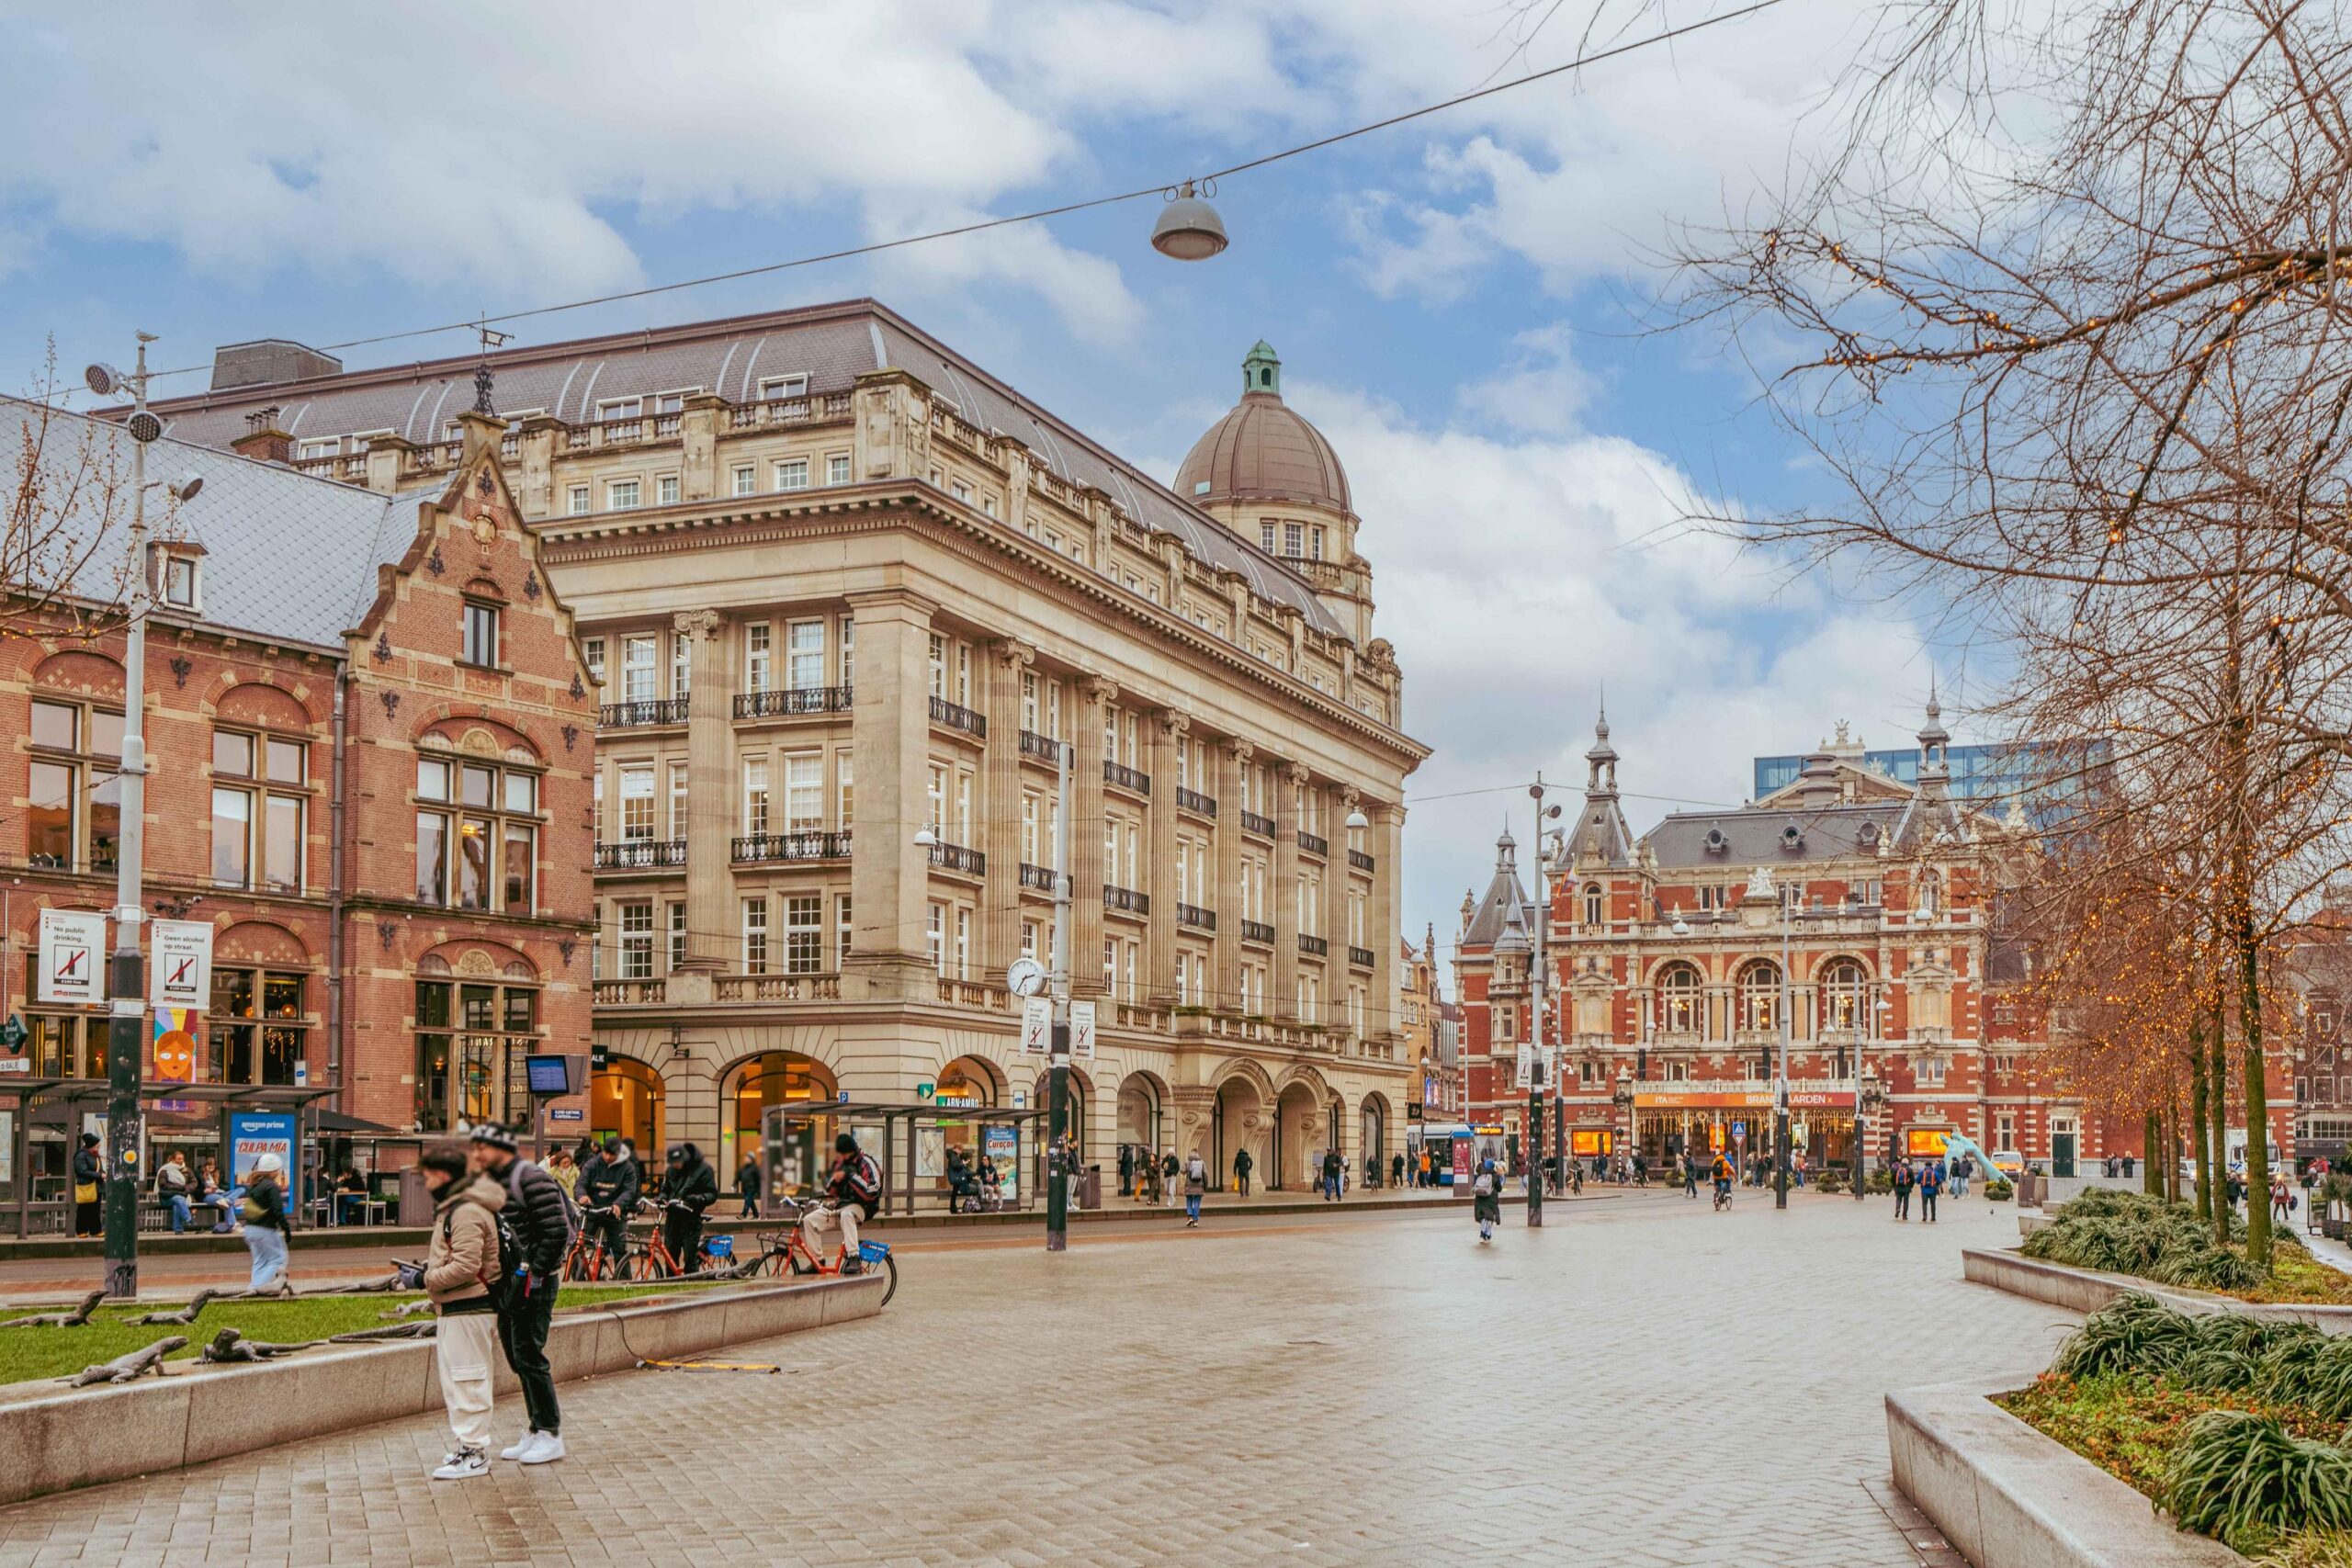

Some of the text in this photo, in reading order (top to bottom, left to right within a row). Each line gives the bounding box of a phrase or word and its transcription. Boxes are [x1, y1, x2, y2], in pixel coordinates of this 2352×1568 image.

[242, 1121, 285, 1130] amazon prime
[239, 1142, 266, 1152] CULPA
[988, 1139, 1013, 1151] Curaçao
